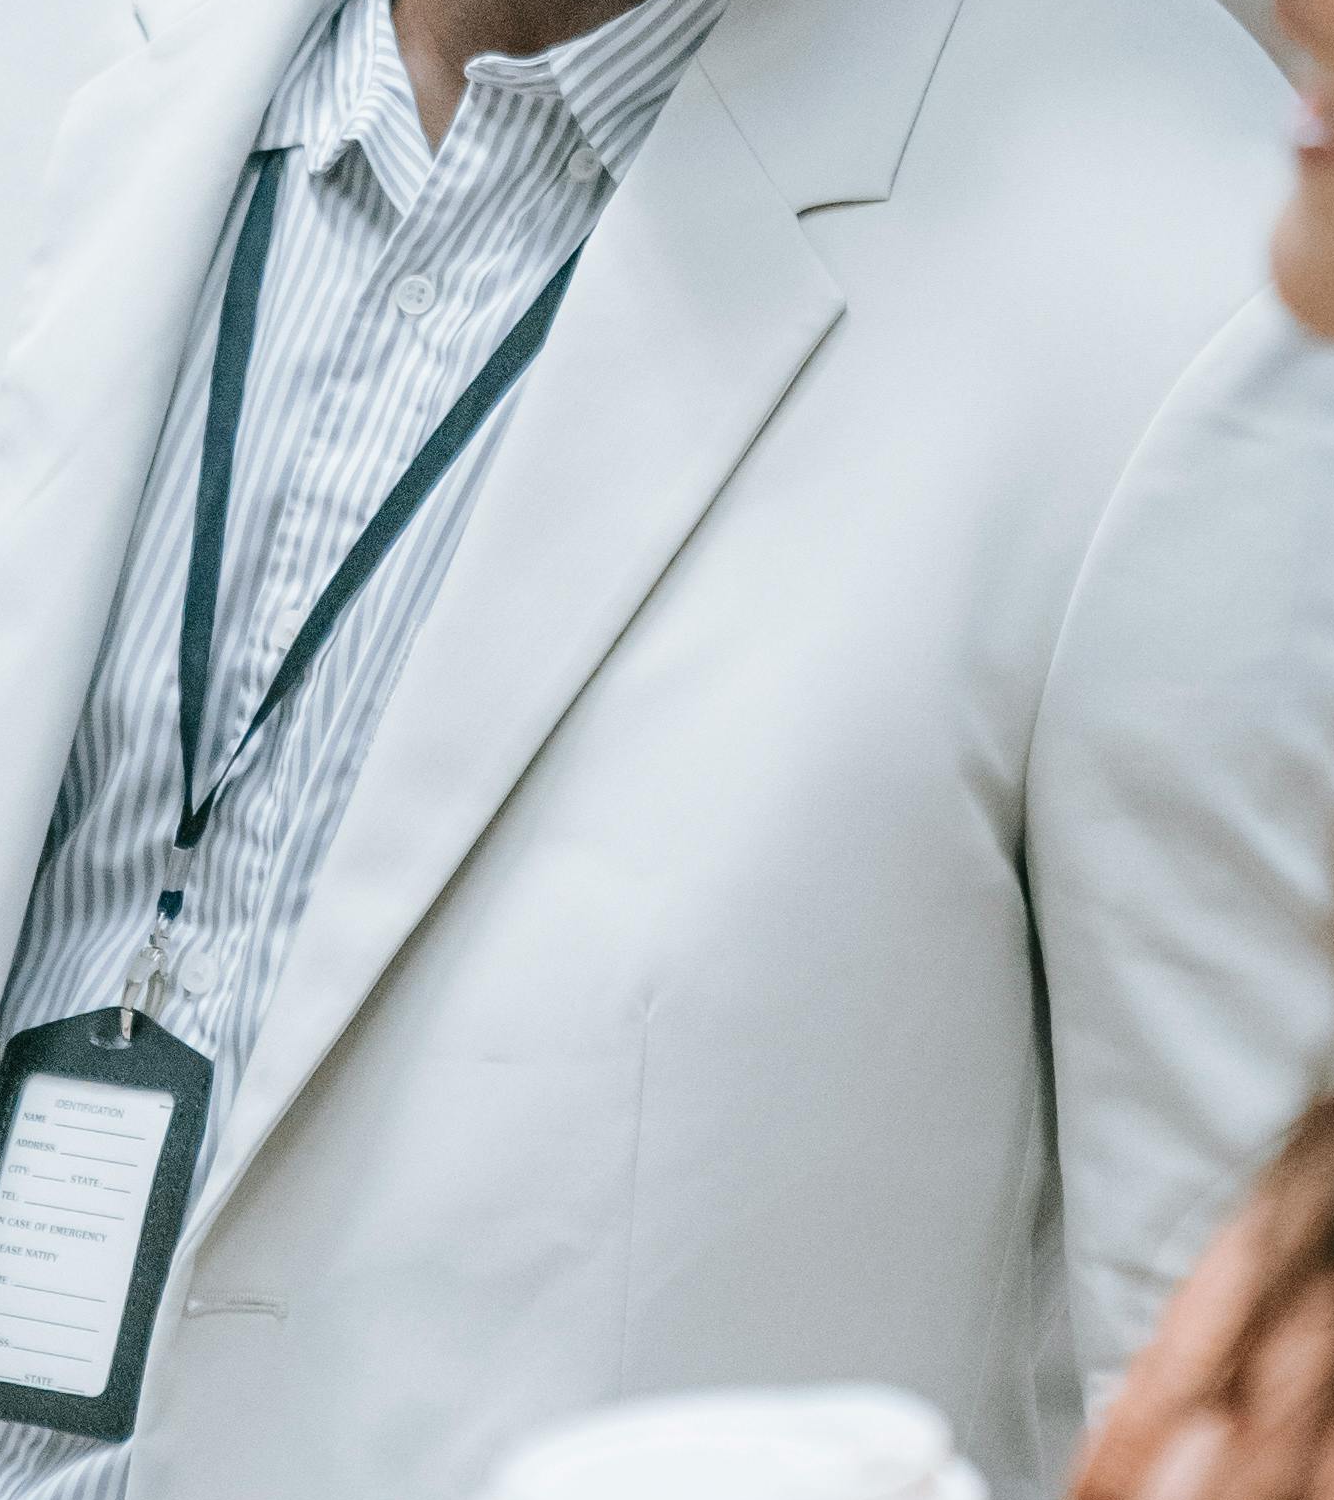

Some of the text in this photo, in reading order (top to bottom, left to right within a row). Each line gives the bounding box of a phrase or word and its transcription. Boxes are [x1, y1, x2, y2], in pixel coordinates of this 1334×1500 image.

[55, 1098, 125, 1118] IDENTIFICATION
[8, 1218, 31, 1229] CASE
[34, 1222, 47, 1232] OF
[49, 1225, 107, 1242] EMERGENCY
